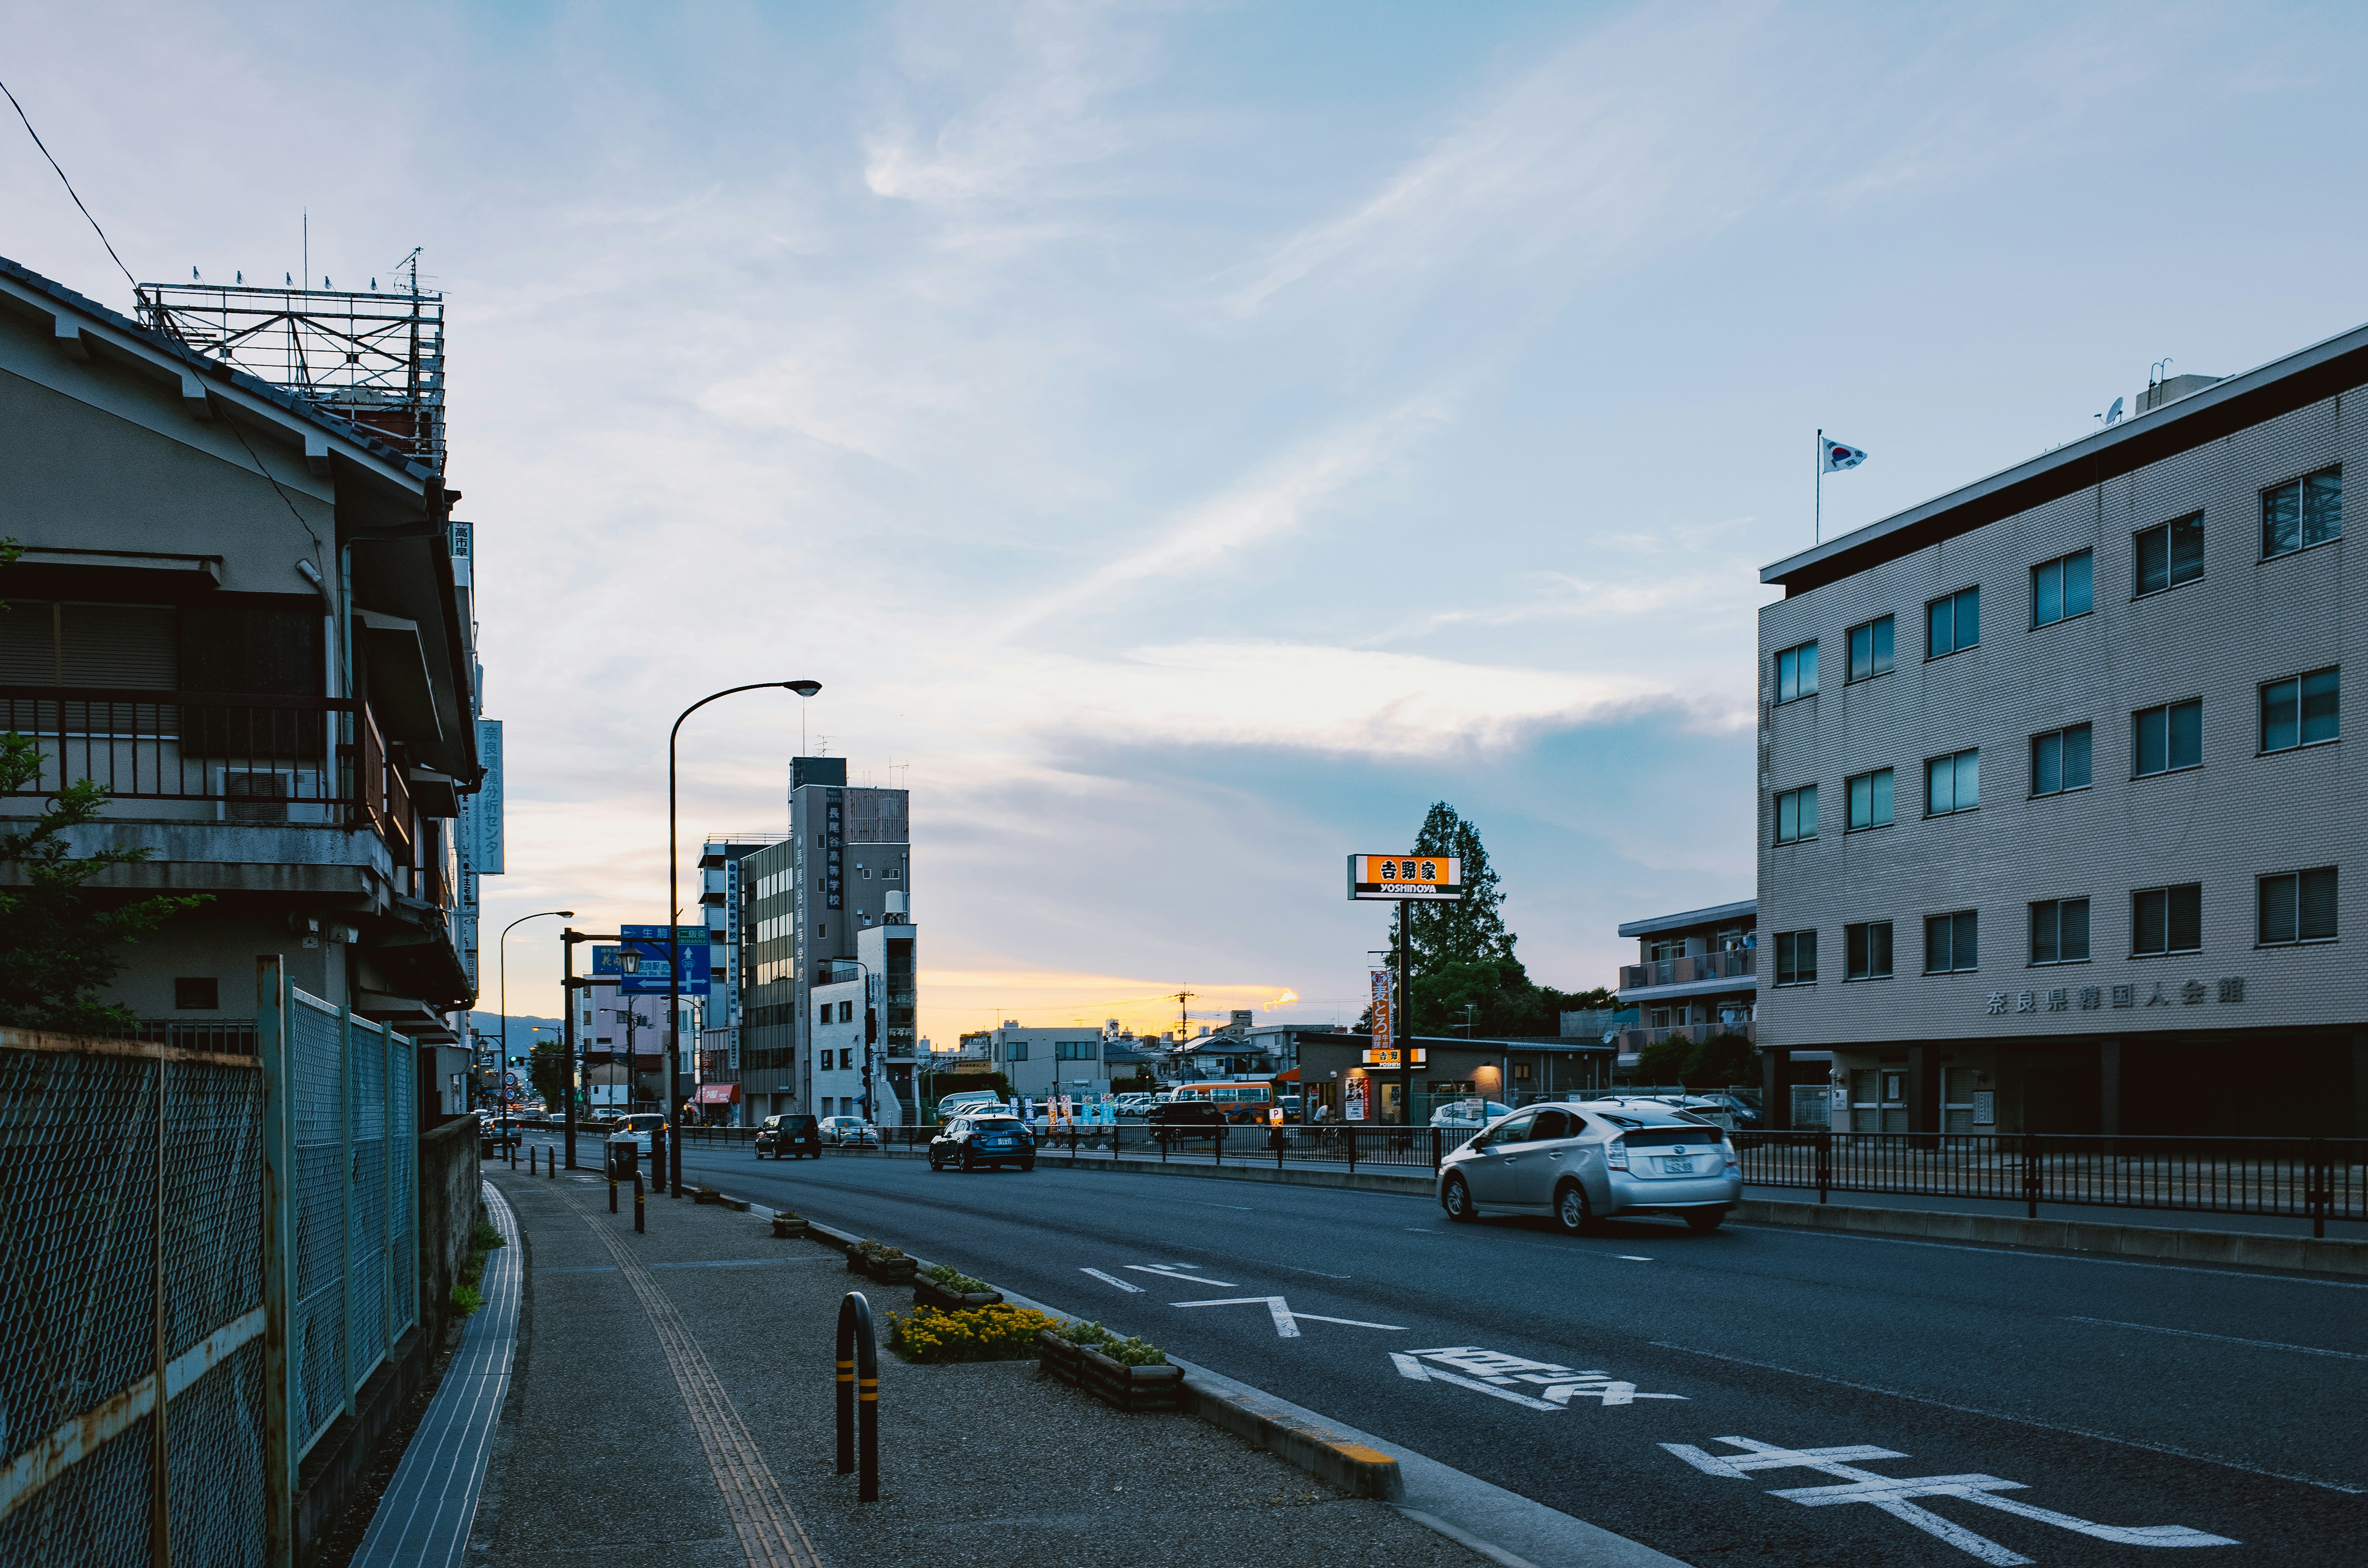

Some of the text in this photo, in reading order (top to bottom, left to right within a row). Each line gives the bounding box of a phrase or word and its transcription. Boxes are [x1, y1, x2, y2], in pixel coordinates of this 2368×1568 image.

[455, 527, 468, 556] 高市早
[483, 726, 499, 868] 奈良環境分析センター
[828, 807, 840, 906] 長尾谷高等学校
[1380, 859, 1436, 881] 吉野家
[1381, 883, 1436, 893] YOSHINOYA
[728, 873, 737, 940] 長尾谷高等学校
[642, 928, 667, 938] 生駒
[639, 962, 671, 970] 奈良駅西
[1375, 973, 1383, 983] 新
[1987, 976, 2244, 1015] 奈良県韓国人会館
[1372, 985, 1388, 1034] 麦とろ
[1379, 1050, 1399, 1061] 吉野
[1274, 1110, 1279, 1118] P
